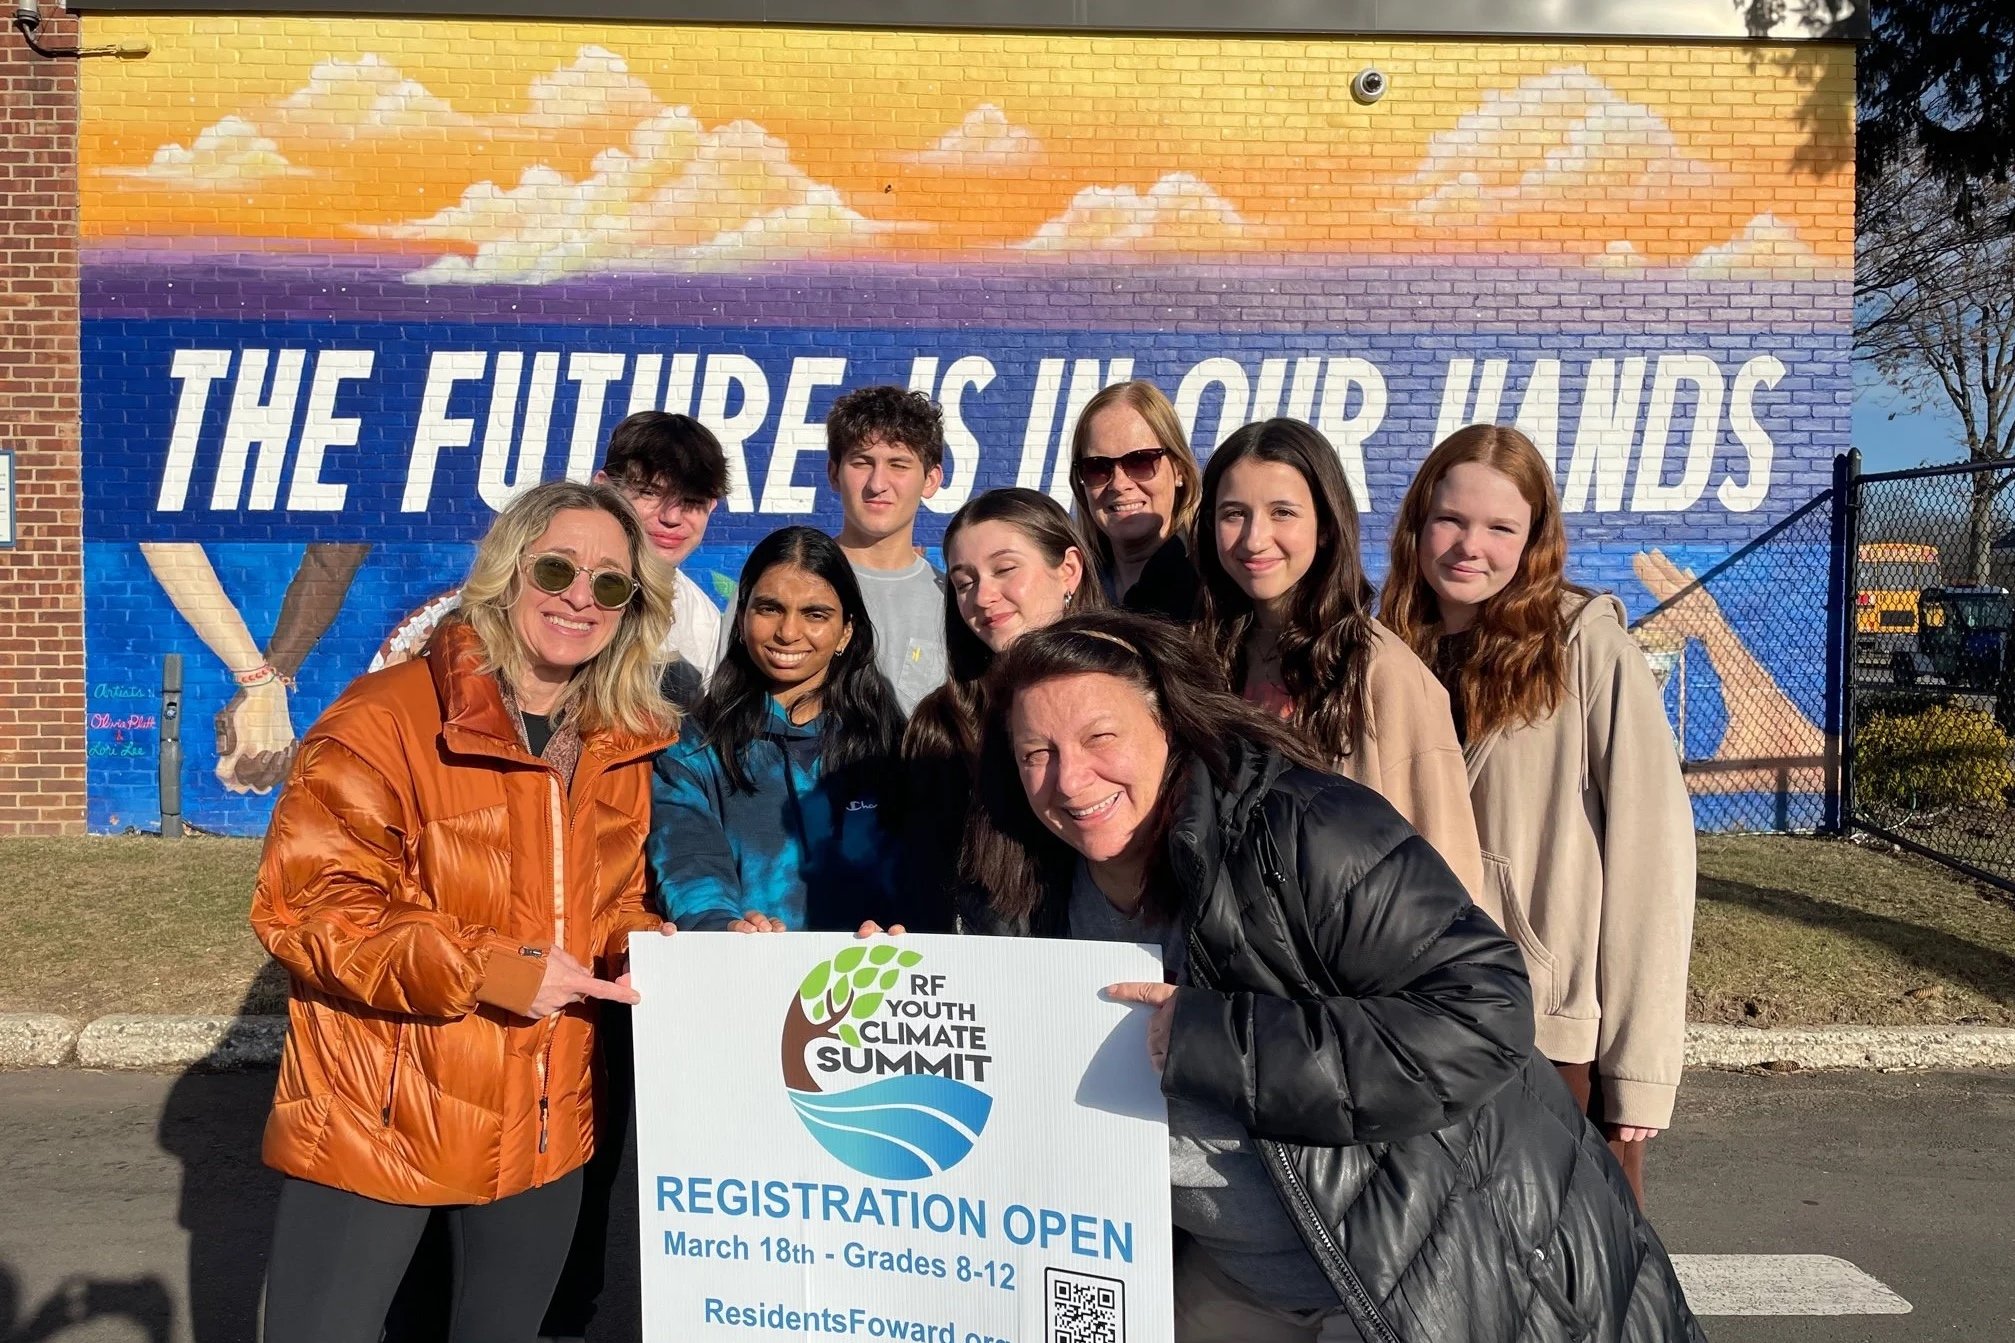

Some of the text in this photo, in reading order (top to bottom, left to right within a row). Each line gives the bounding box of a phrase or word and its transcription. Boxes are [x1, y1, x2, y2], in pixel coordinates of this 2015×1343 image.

[156, 348, 375, 512] THE
[902, 355, 997, 514] S
[89, 741, 117, 756] Lori
[910, 974, 946, 997] RF
[885, 999, 976, 1022] YOUTH
[859, 1020, 987, 1051] CLIMATE
[816, 1046, 993, 1083] SUMMIT
[656, 1175, 1133, 1263] REGISTRATION OPEN
[664, 1230, 749, 1261] March
[760, 1236, 815, 1265] 18th
[843, 1241, 947, 1279] Grades
[956, 1255, 1015, 1291] 8-12
